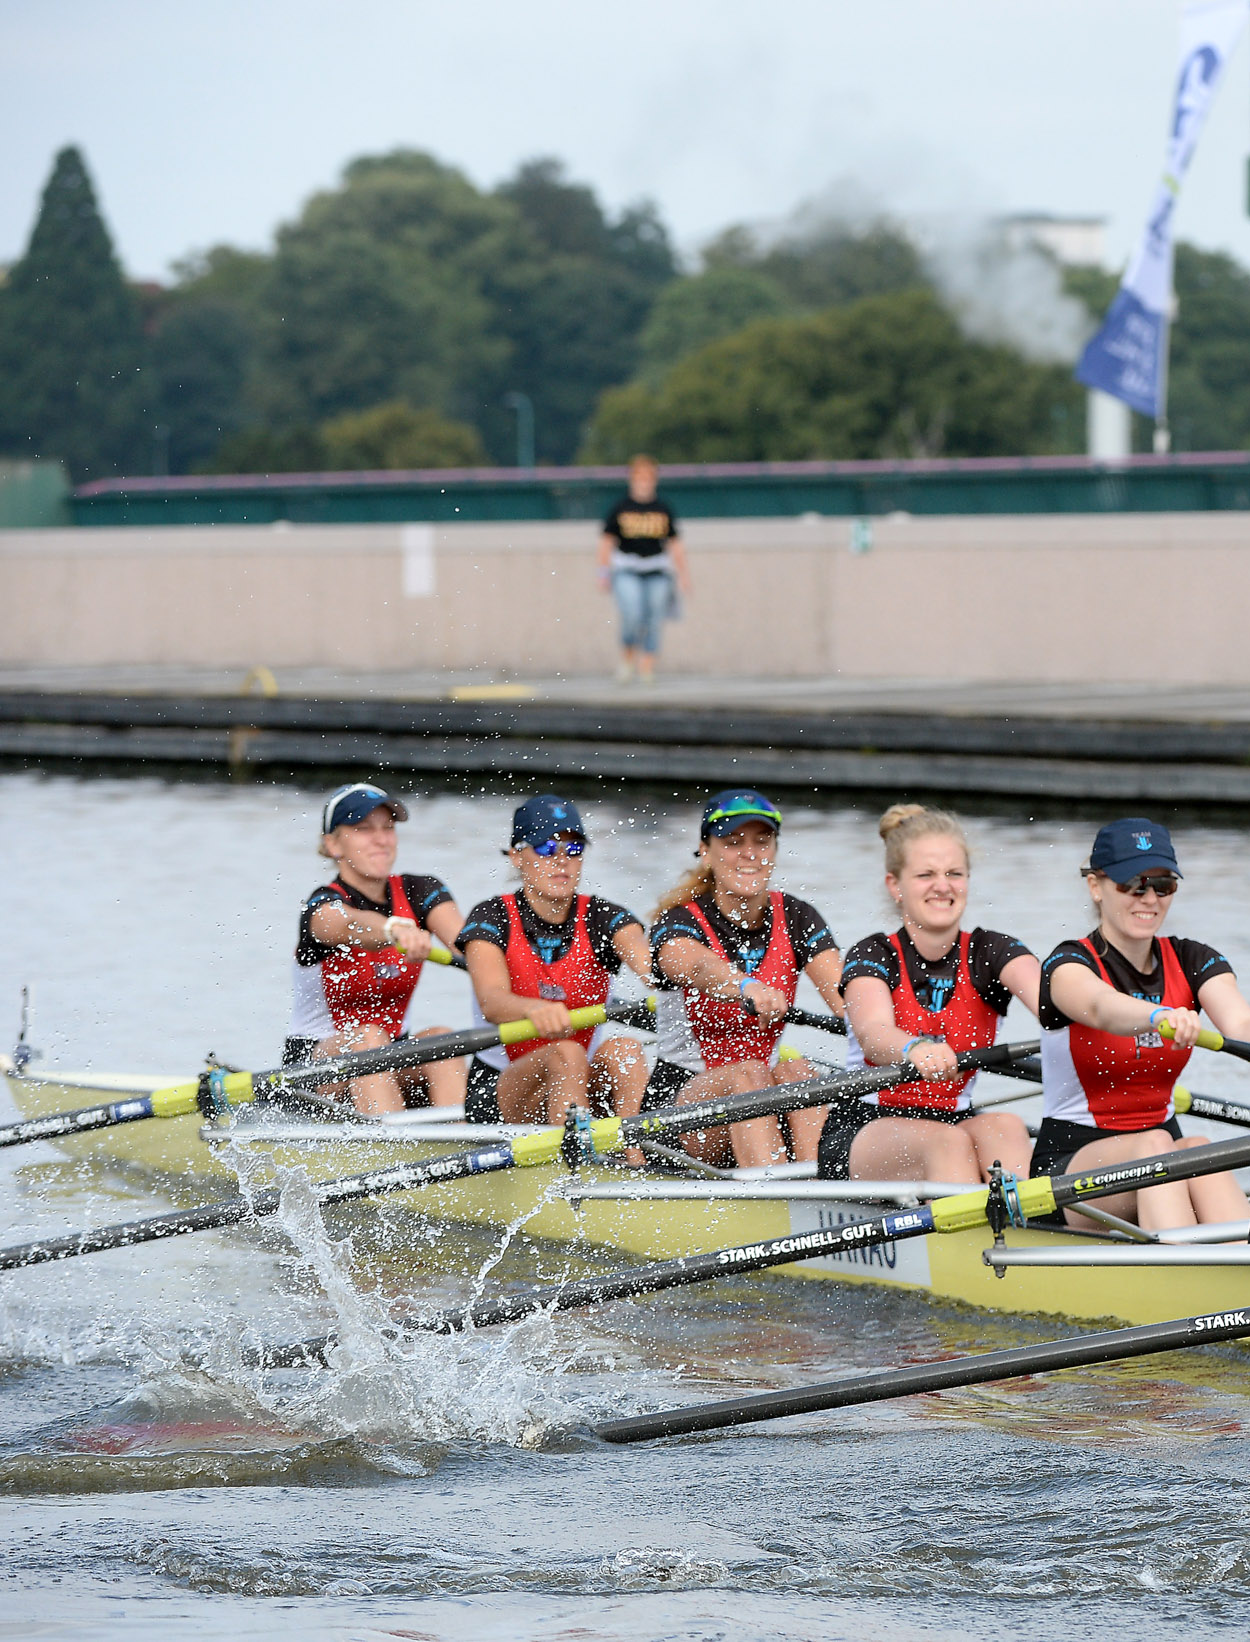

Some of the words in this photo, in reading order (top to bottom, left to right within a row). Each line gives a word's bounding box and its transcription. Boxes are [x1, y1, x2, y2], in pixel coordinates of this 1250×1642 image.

[1094, 1164, 1153, 1185] concept
[1154, 1162, 1164, 1172] 2
[718, 1246, 770, 1264] STARK.
[770, 1231, 841, 1256] SCHNELL.
[841, 1223, 877, 1241] GUT.
[894, 1214, 923, 1228] RBL
[1194, 1313, 1250, 1331] STARK.
